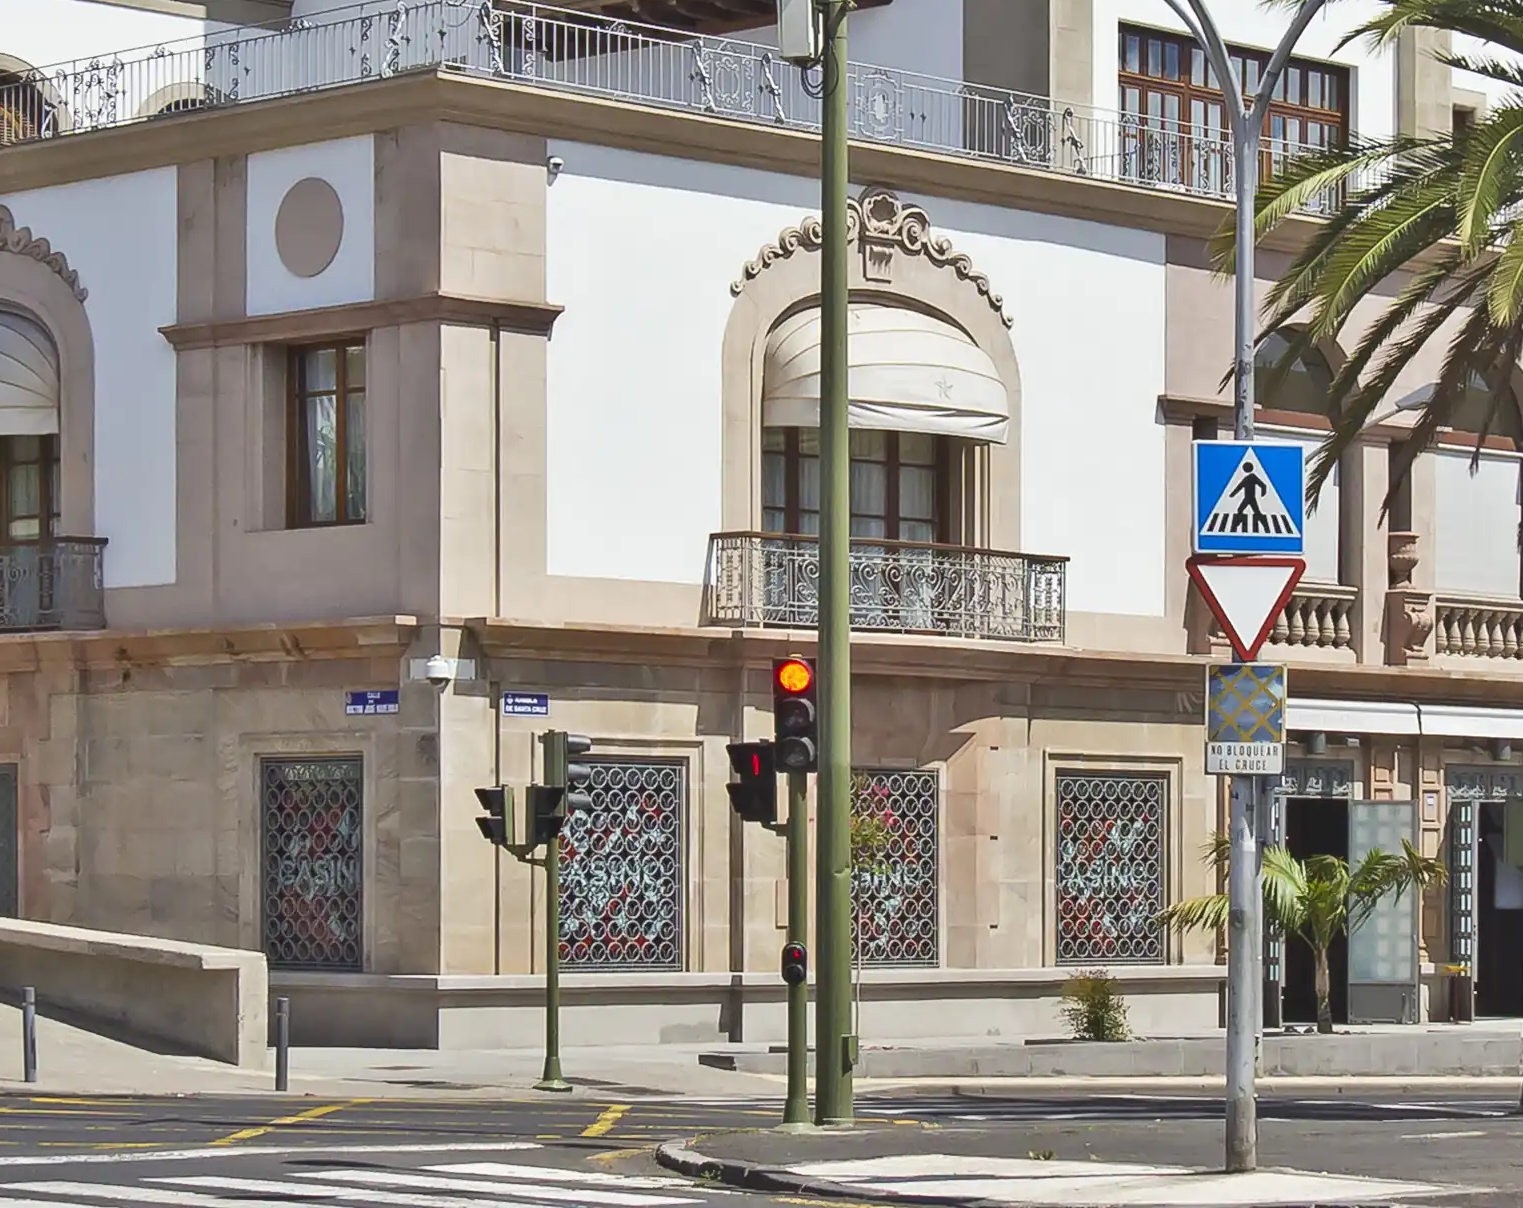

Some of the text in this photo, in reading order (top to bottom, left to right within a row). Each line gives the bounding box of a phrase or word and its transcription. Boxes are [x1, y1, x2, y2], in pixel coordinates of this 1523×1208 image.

[1211, 745, 1278, 757] NO BLOQUEAR
[1219, 759, 1267, 770] EL CRUCE
